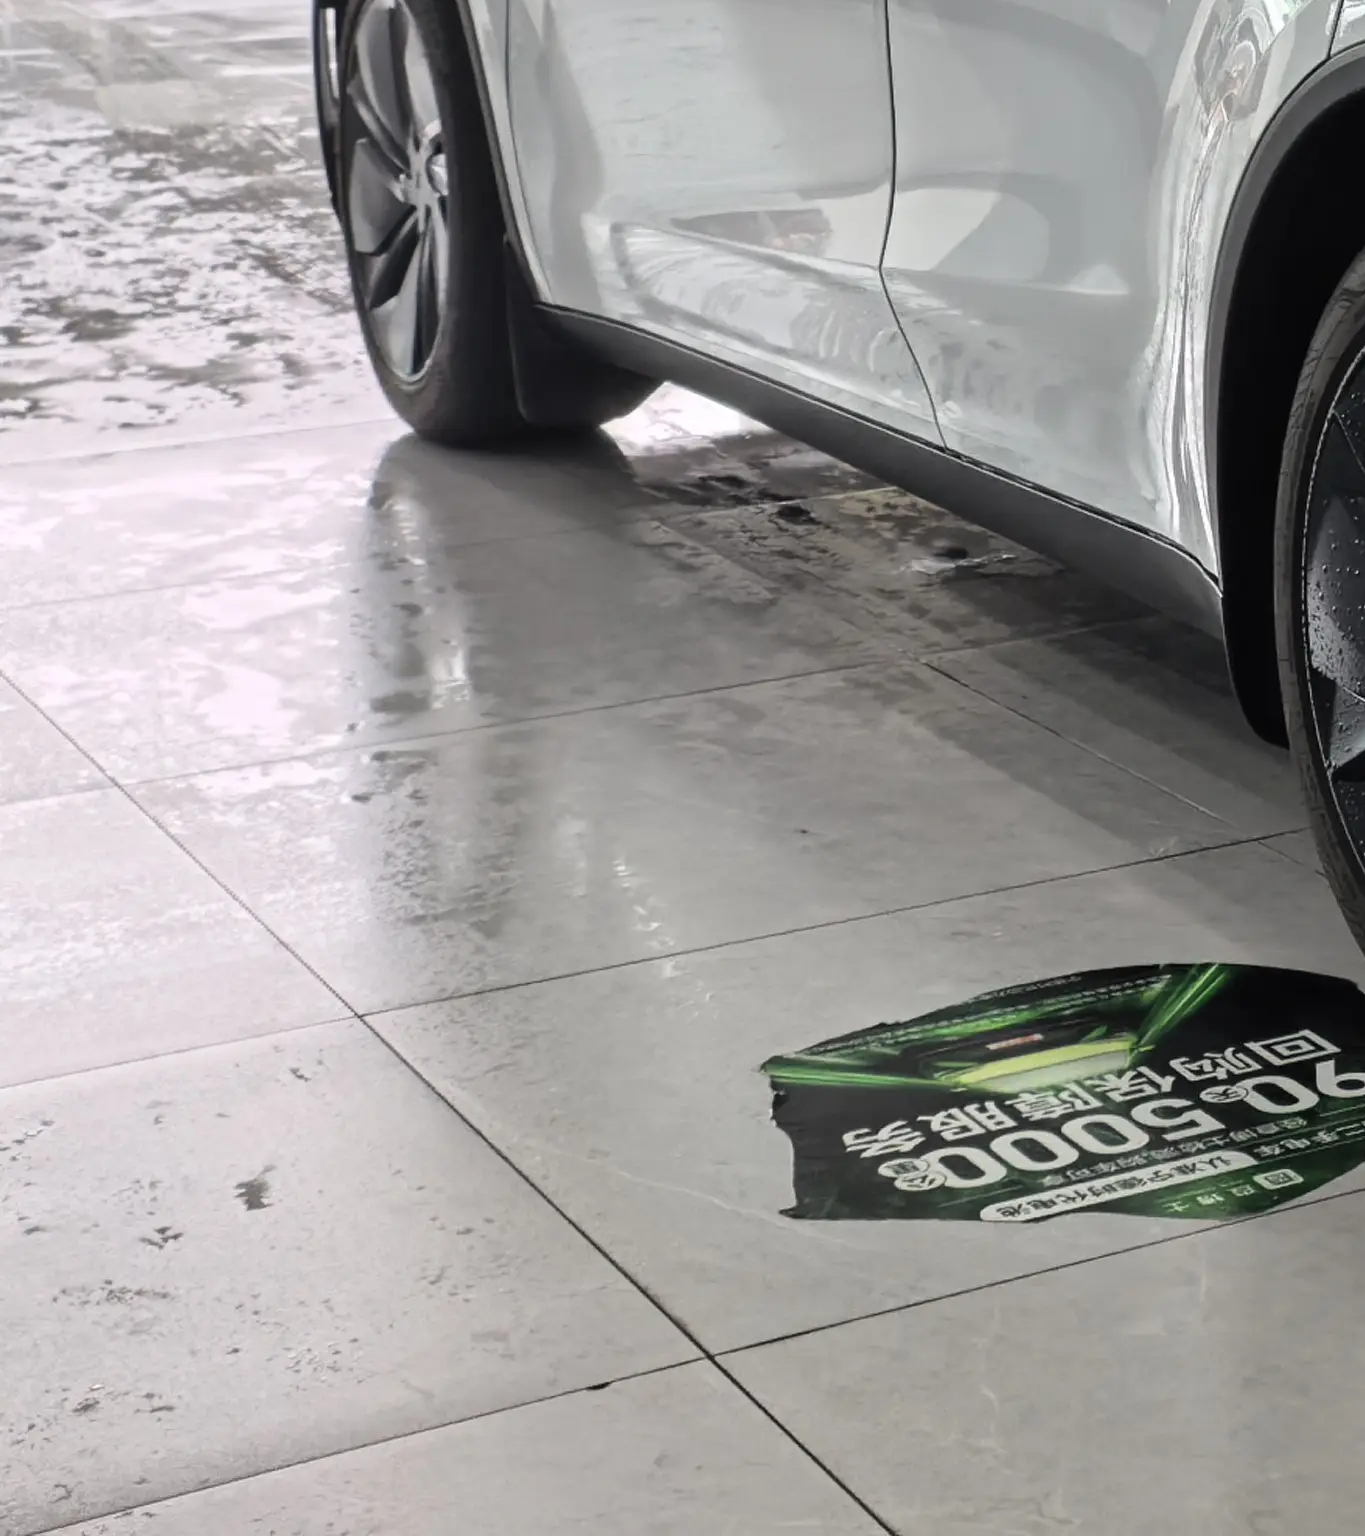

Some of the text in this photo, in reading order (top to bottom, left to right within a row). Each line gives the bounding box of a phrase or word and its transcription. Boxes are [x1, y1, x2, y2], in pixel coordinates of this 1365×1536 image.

[843, 1029, 1341, 1159] 回购保障服务
[996, 1155, 1231, 1220] 认准宁德时代电池
